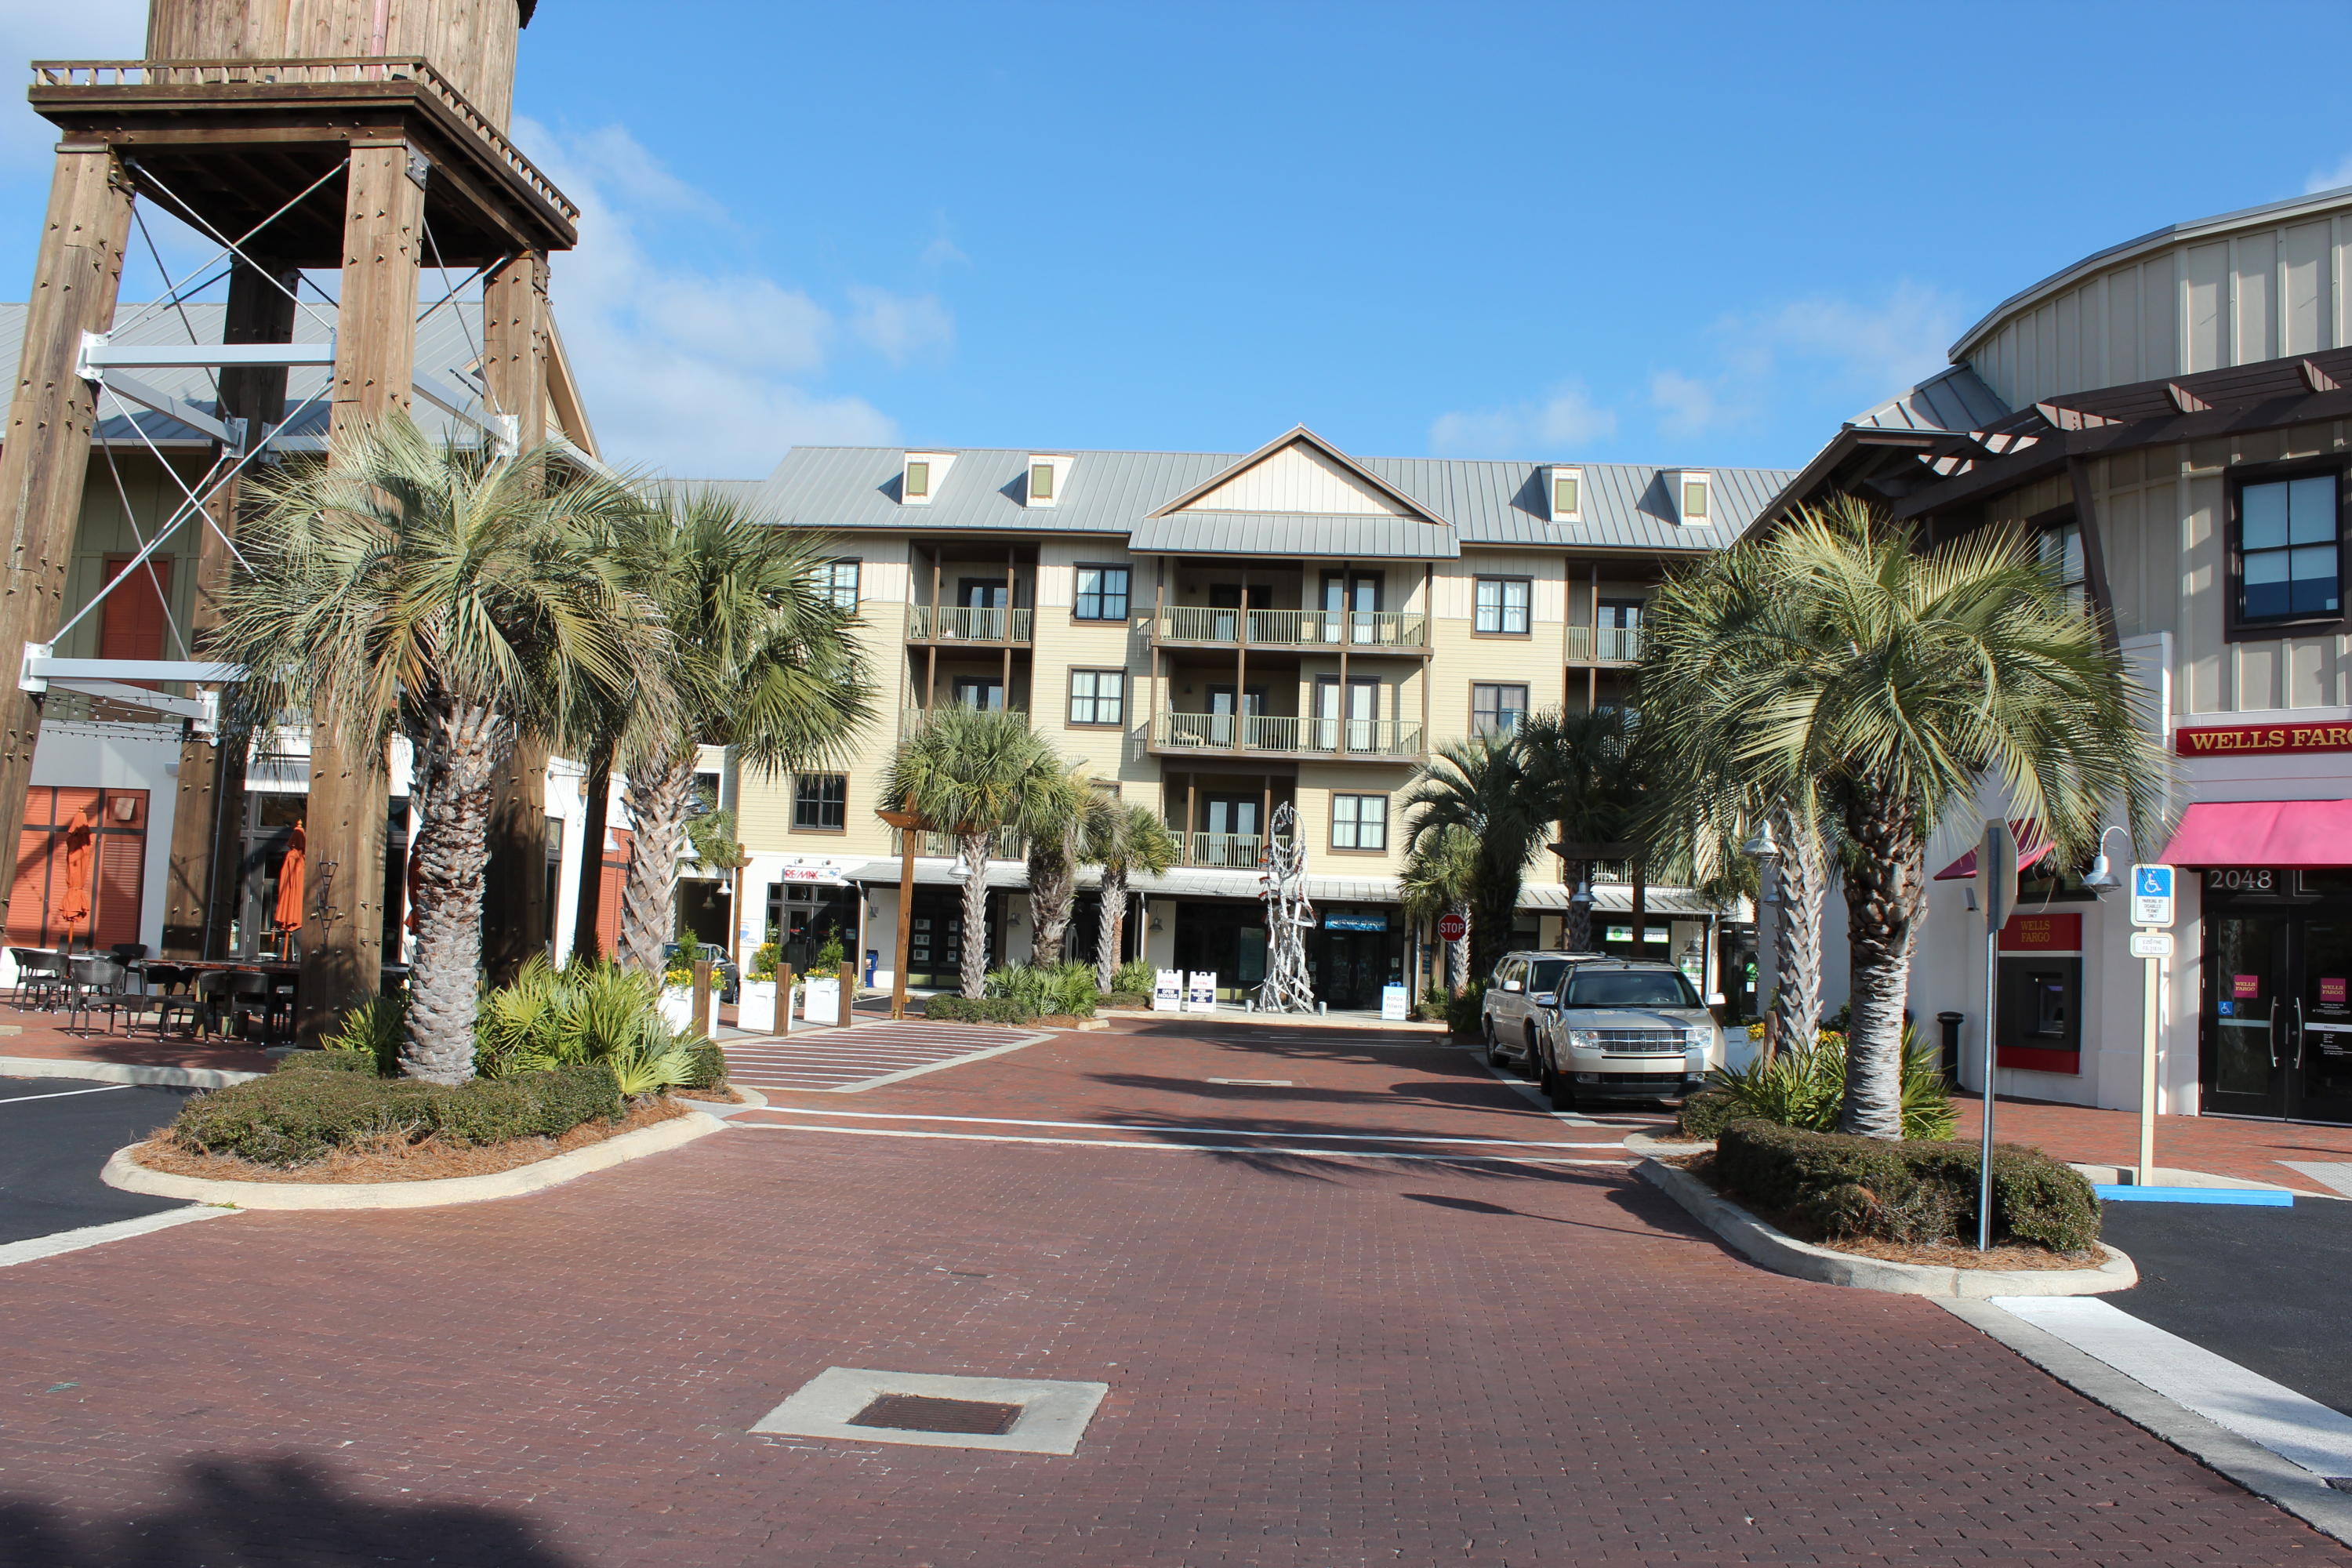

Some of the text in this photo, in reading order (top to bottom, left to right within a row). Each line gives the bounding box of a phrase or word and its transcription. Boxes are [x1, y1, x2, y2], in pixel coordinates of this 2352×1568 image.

[2190, 730, 2285, 750] WELLS
[785, 869, 819, 880] RE/MAX
[2209, 869, 2273, 889] 2048
[1440, 923, 1465, 934] STOP
[2020, 920, 2050, 931] WELLS
[2020, 932, 2050, 942] FARGO
